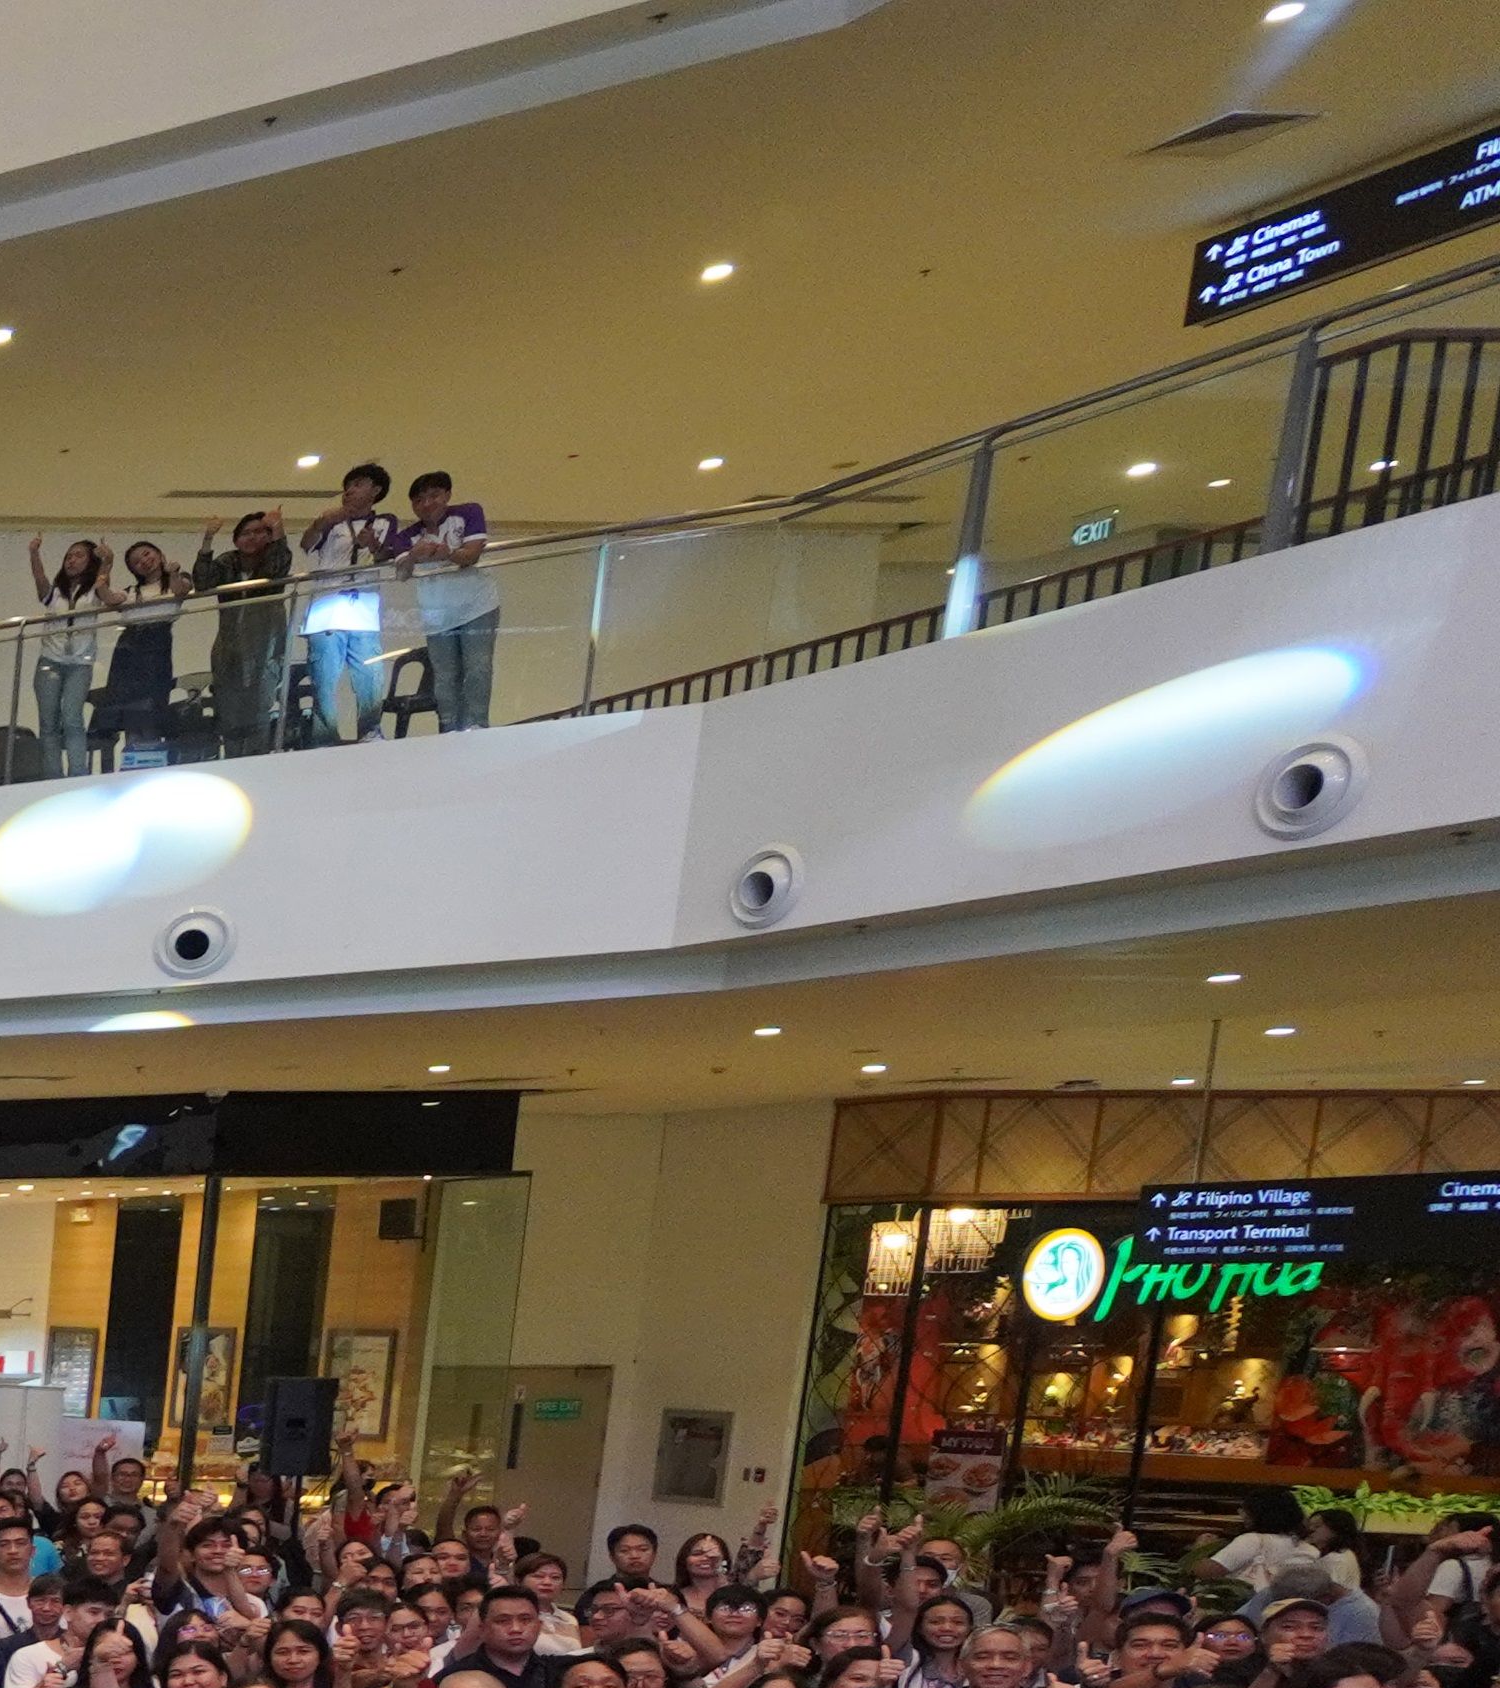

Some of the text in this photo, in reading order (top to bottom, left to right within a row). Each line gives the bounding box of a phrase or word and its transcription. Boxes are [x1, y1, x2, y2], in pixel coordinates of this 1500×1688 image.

[1253, 210, 1320, 244] Cinemas
[1246, 258, 1292, 284] China
[1297, 240, 1340, 265] Town
[1077, 518, 1112, 545] EXIT
[1195, 1189, 1312, 1208] Filipino Village
[1167, 1223, 1310, 1243] Transport Terminal
